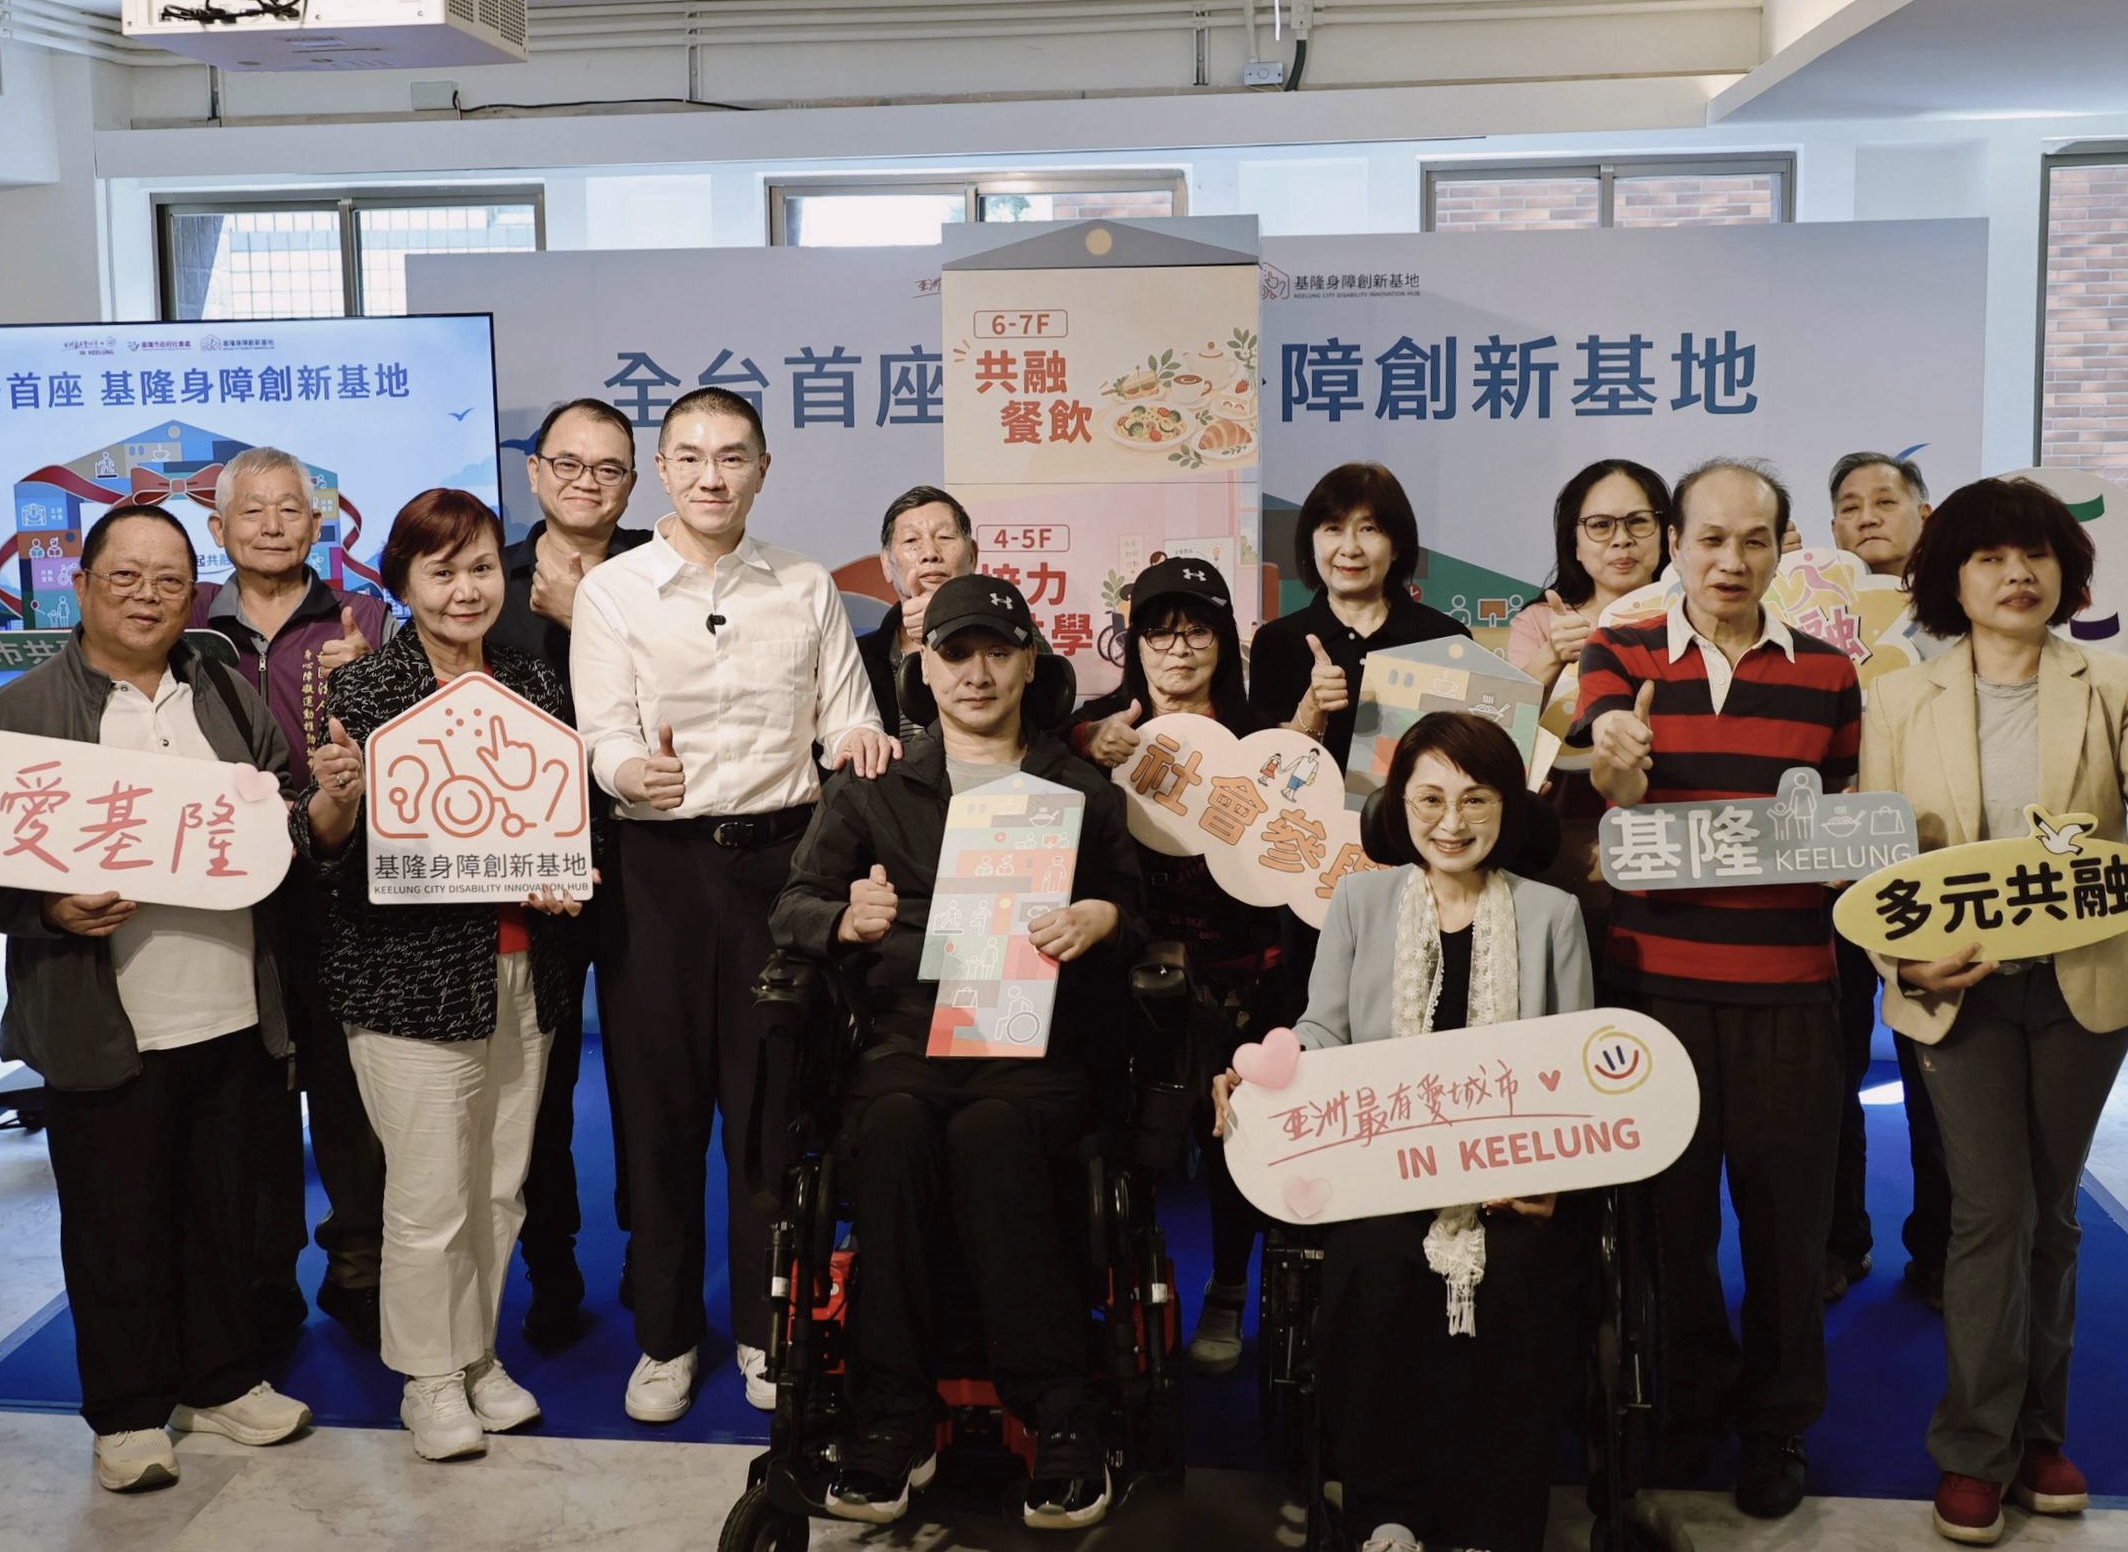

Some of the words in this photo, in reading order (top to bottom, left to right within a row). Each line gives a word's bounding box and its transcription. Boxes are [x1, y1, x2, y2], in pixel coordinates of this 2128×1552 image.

[1294, 273, 1421, 290] 基隆身障創新基地
[992, 314, 1050, 335] 6-7F
[6, 371, 85, 410] 首座
[100, 362, 410, 407] 基隆身障創新基地
[603, 344, 943, 428] 全台首座
[975, 350, 1068, 394] 共融
[1262, 330, 1758, 422] 障創新基地
[1001, 399, 1093, 444] 餐飲
[994, 528, 1052, 549] 4-5F
[1030, 612, 1093, 656] 學
[0, 760, 248, 877] 愛基隆
[1609, 804, 1763, 881] 基隆
[1775, 843, 1912, 872] KEELUNG
[374, 886, 421, 895] KEELUNG
[424, 885, 446, 894] CITY
[449, 884, 501, 893] DISABILITY
[504, 883, 565, 893] INNOVAON
[567, 882, 589, 891] HUB
[375, 853, 588, 879] 基隆身障創新基地
[1876, 854, 2128, 941] 多元共融
[1268, 1059, 1518, 1147] 亞洲最有愛城市
[1397, 1145, 1438, 1180] IN
[1458, 1118, 1641, 1172] KEELUNG
